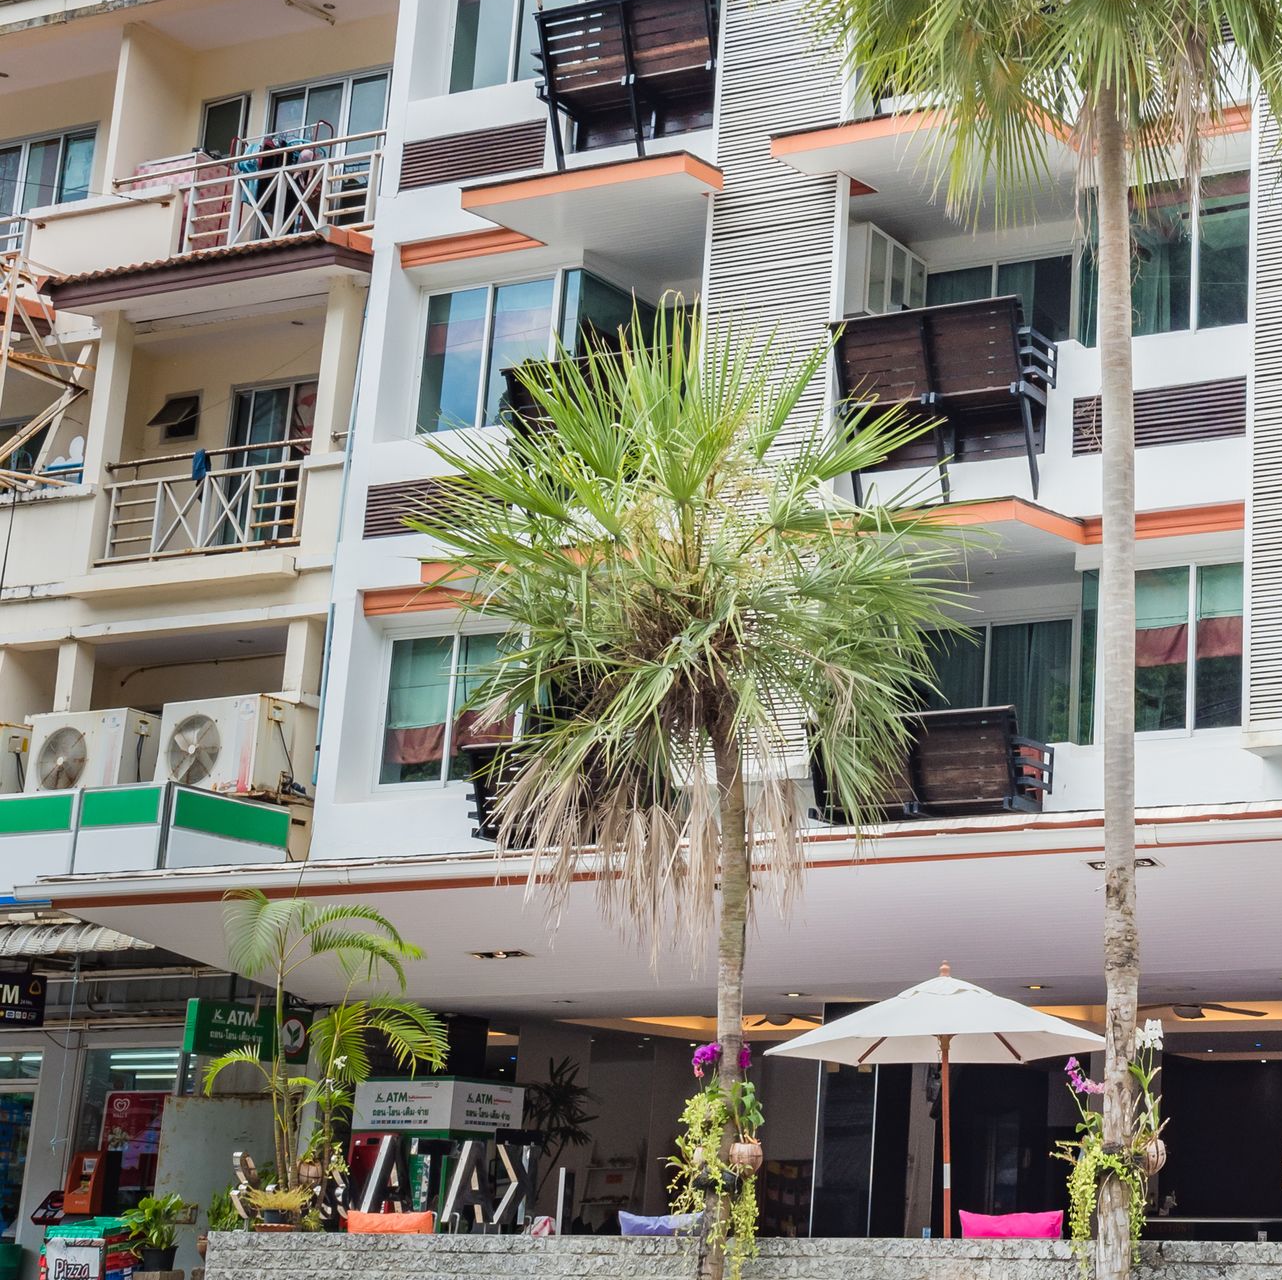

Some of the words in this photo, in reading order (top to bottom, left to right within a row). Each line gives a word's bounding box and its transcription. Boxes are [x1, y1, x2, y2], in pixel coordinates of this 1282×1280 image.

[227, 1009, 257, 1028] ATM
[386, 1092, 408, 1103] ATM
[475, 1093, 493, 1105] ATM
[54, 1258, 90, 1280] Pizza
